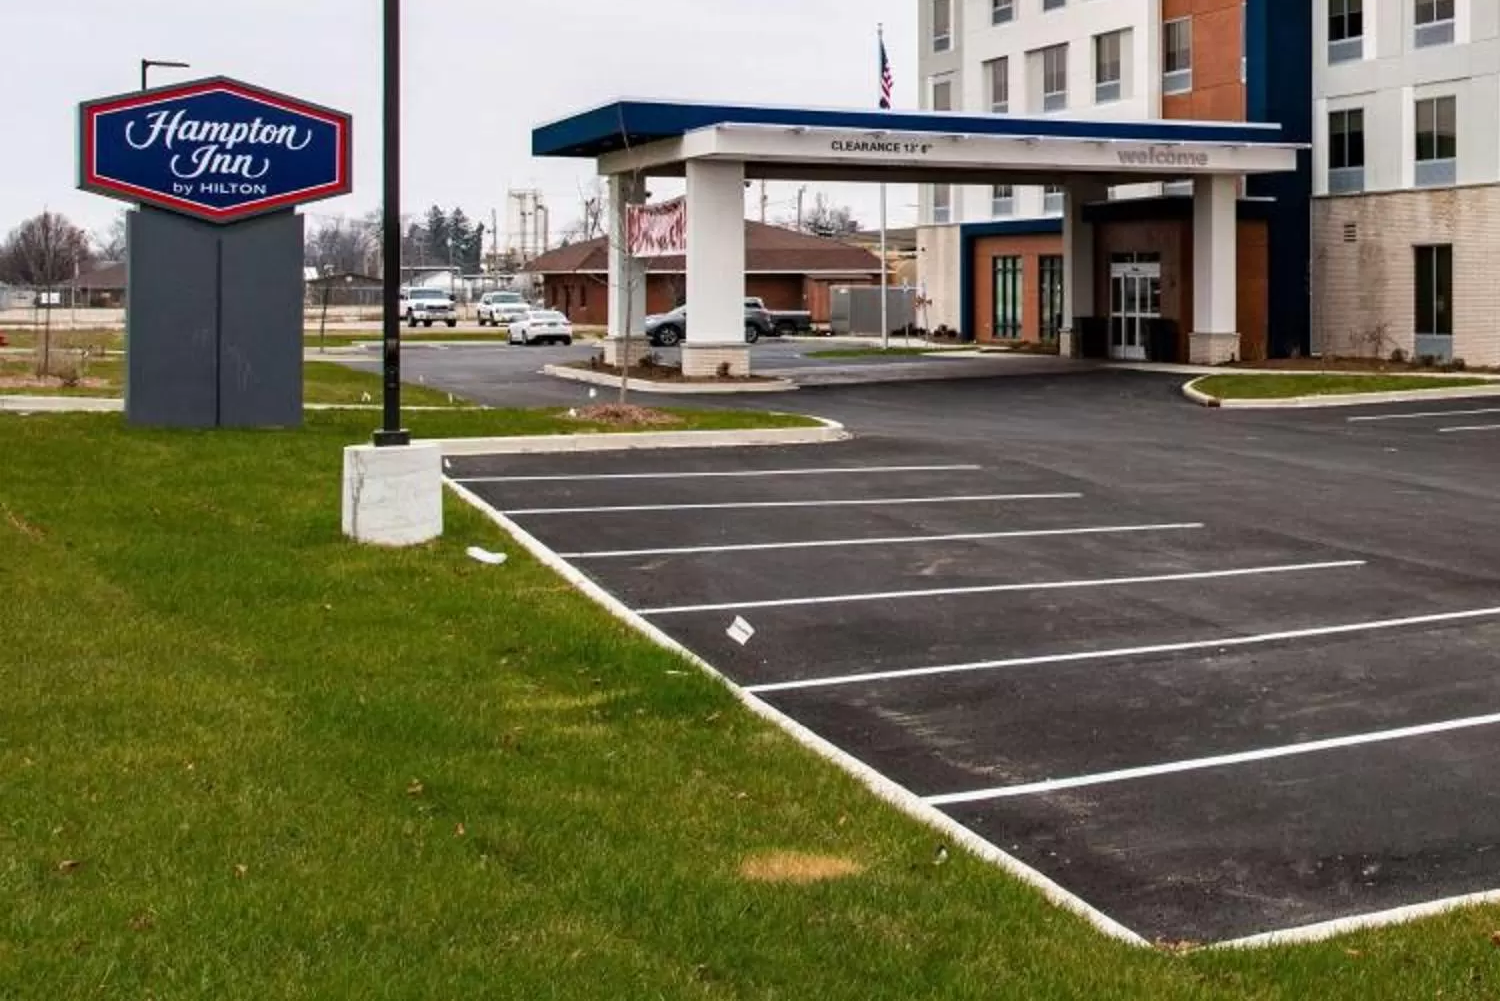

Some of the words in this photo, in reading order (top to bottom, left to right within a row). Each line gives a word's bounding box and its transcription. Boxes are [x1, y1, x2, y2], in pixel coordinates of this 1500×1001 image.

[125, 109, 312, 150] Hampton
[830, 140, 901, 153] CLEARANCE
[1116, 146, 1209, 166] welcome
[170, 144, 269, 179] Inn
[173, 182, 193, 196] by
[200, 182, 267, 195] HILTON
